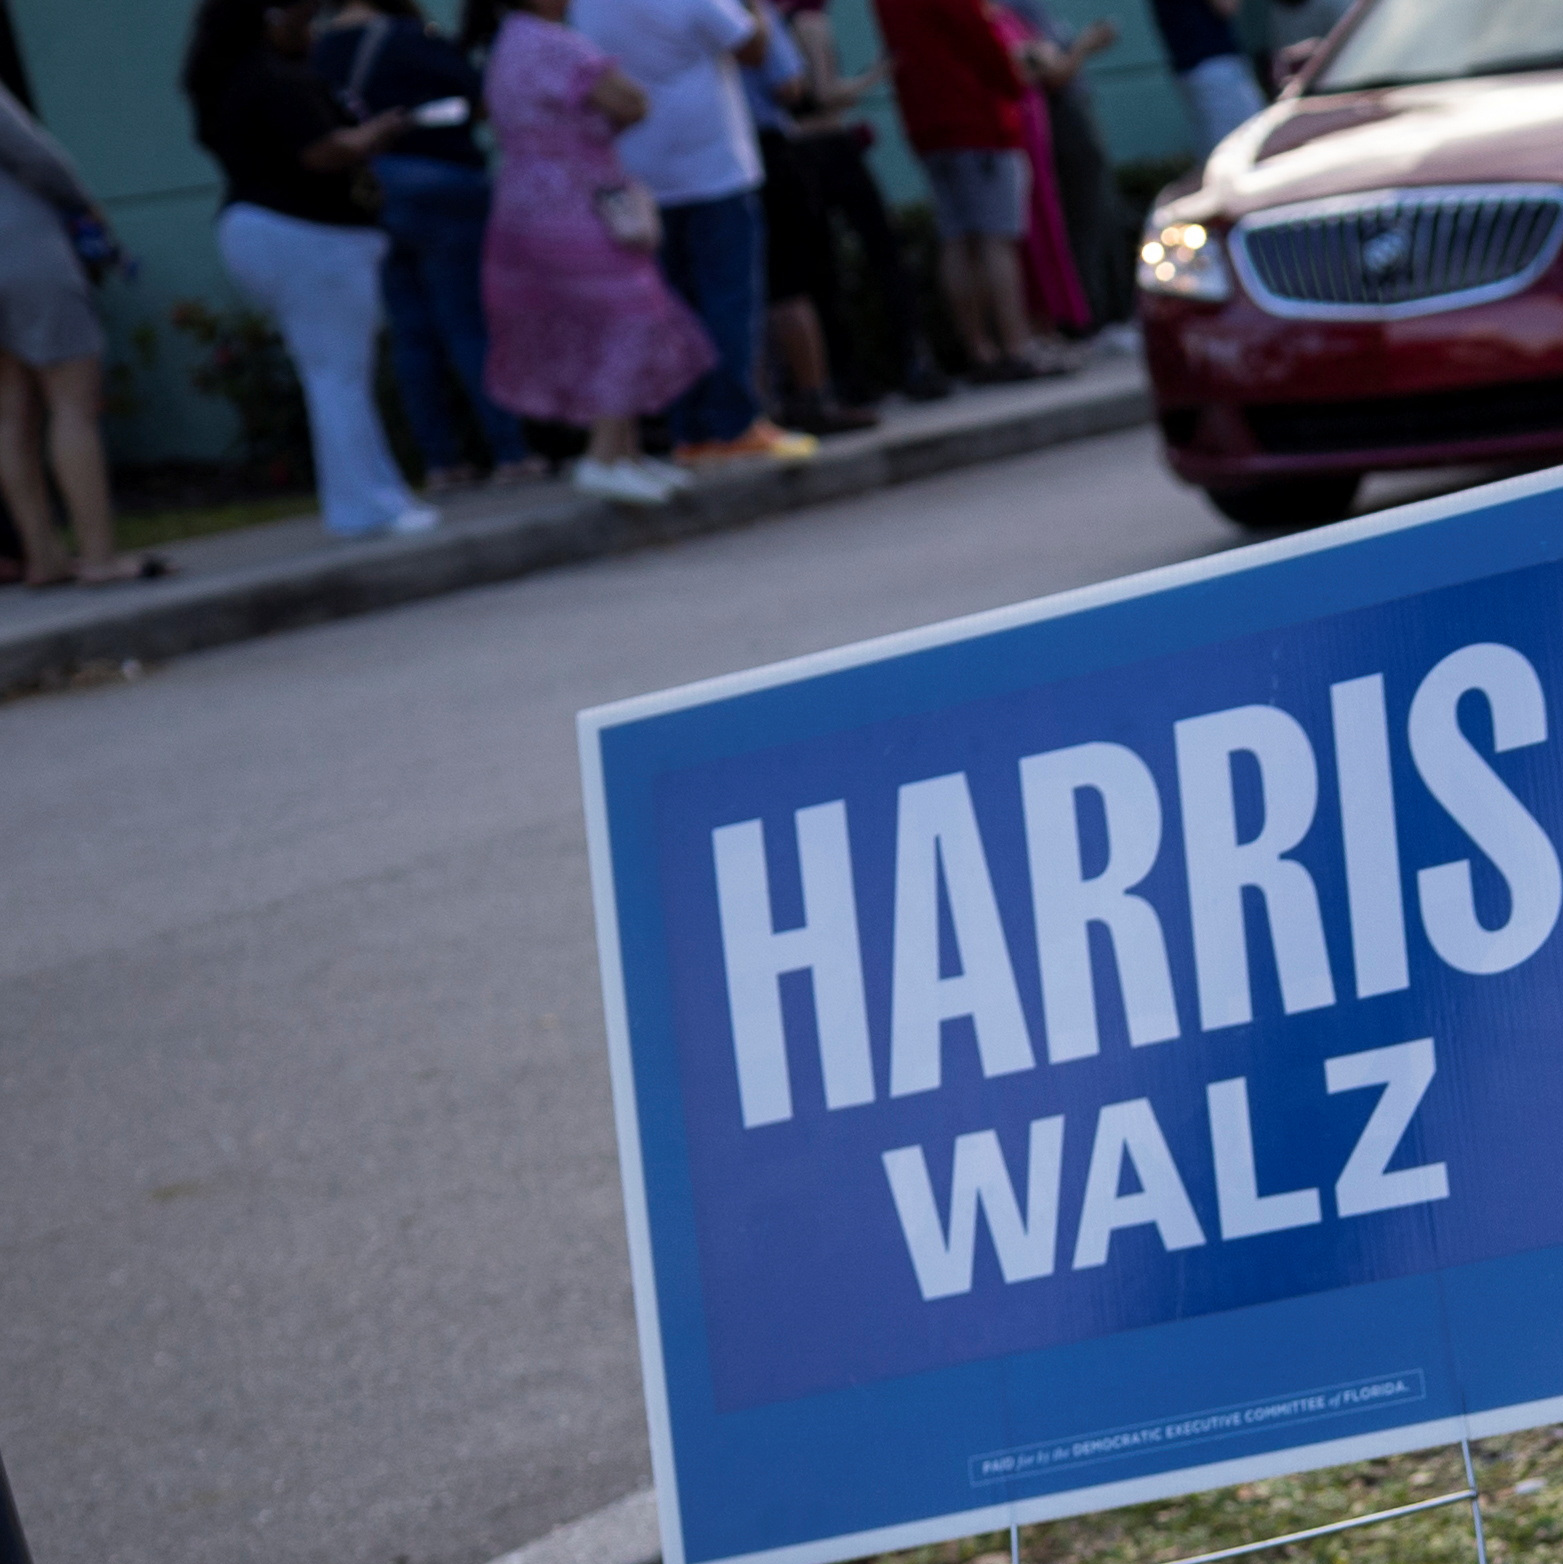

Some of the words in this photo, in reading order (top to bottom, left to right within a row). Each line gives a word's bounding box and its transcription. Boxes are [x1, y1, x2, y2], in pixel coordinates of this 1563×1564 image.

[712, 643, 1563, 1129] HARRIS
[881, 1037, 1450, 1300] WALZ
[981, 1455, 1016, 1476] PAID
[1071, 1427, 1163, 1458] DEMOCRATIC
[1165, 1410, 1242, 1440] EXECUTIVE
[1243, 1394, 1327, 1425] COMMITTEE
[1328, 1392, 1343, 1410] of
